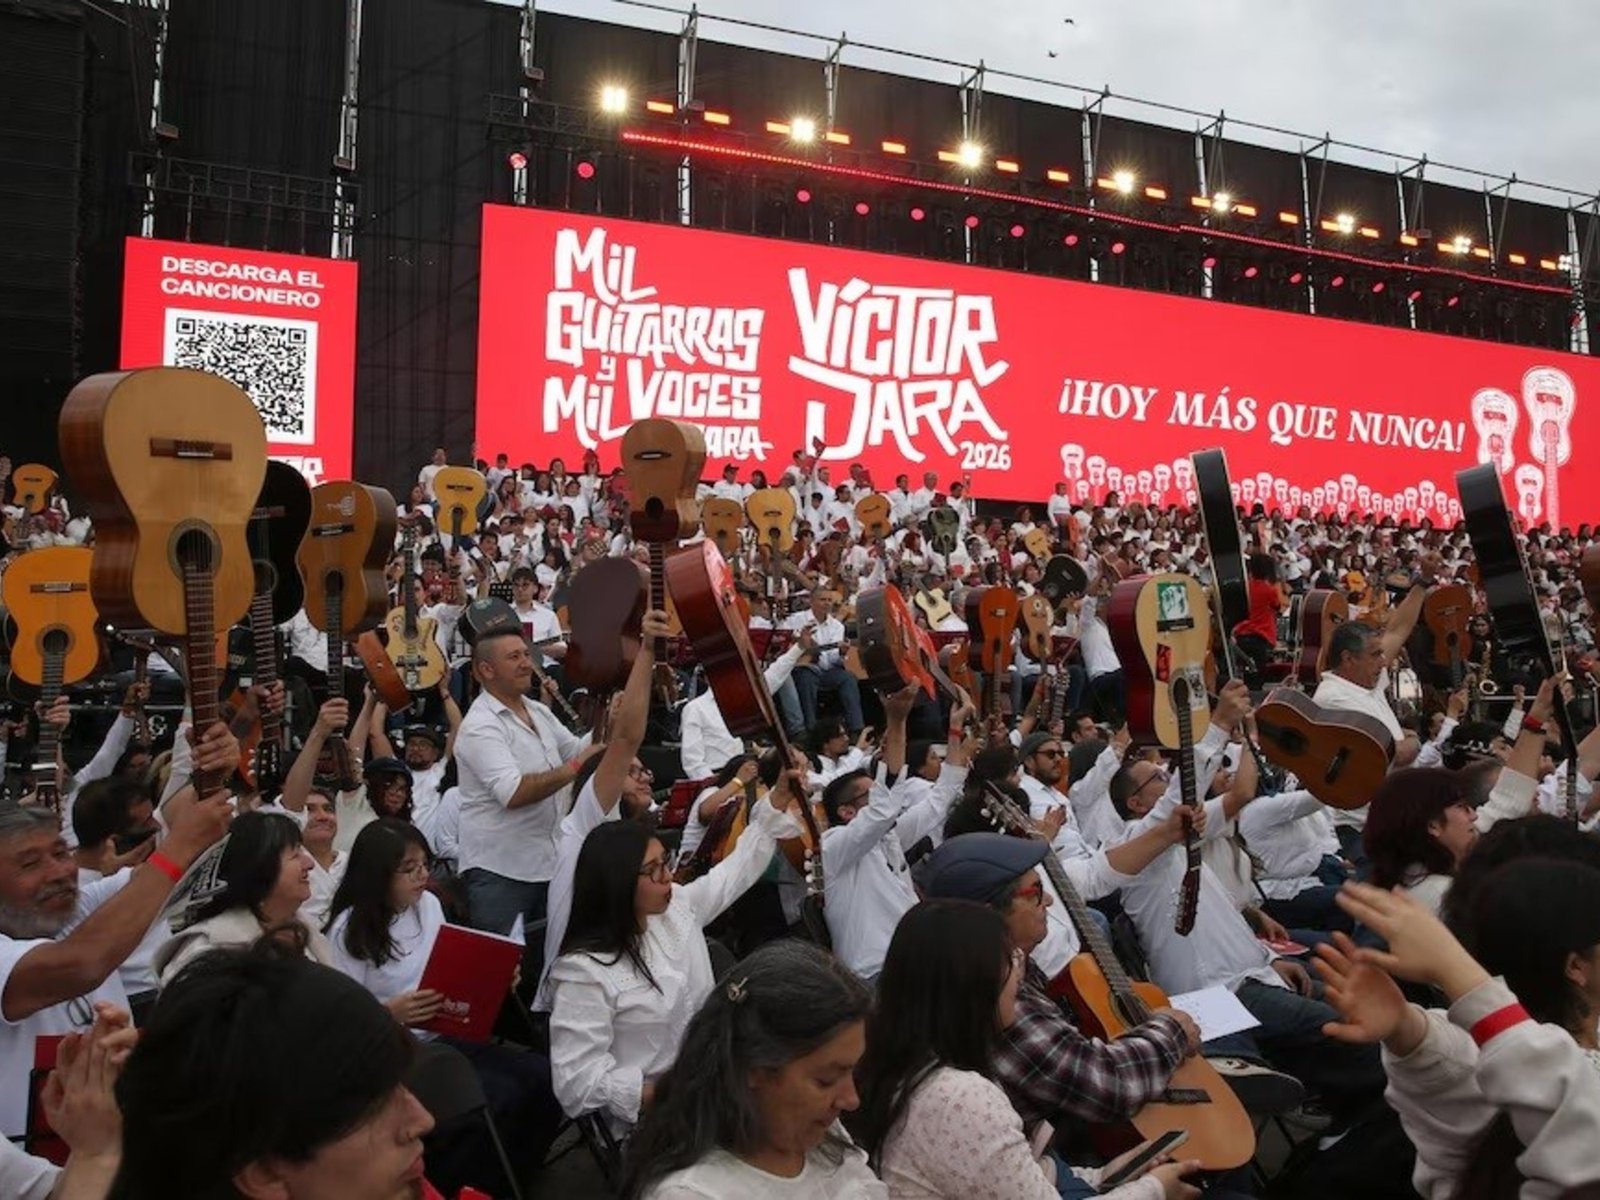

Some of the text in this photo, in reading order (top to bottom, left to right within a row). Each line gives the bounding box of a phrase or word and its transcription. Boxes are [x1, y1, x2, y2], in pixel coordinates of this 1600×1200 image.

[161, 277, 321, 308] CANCIONERO
[162, 256, 325, 289] DESCARGA EL
[788, 267, 1010, 388] VÍCTOR
[626, 358, 762, 420] VOCES
[788, 355, 1009, 464] JARA
[1058, 378, 1466, 453] ¡HOY MÁS QUE NUNCA!
[694, 424, 775, 461] ARA
[960, 440, 1012, 471] 2026
